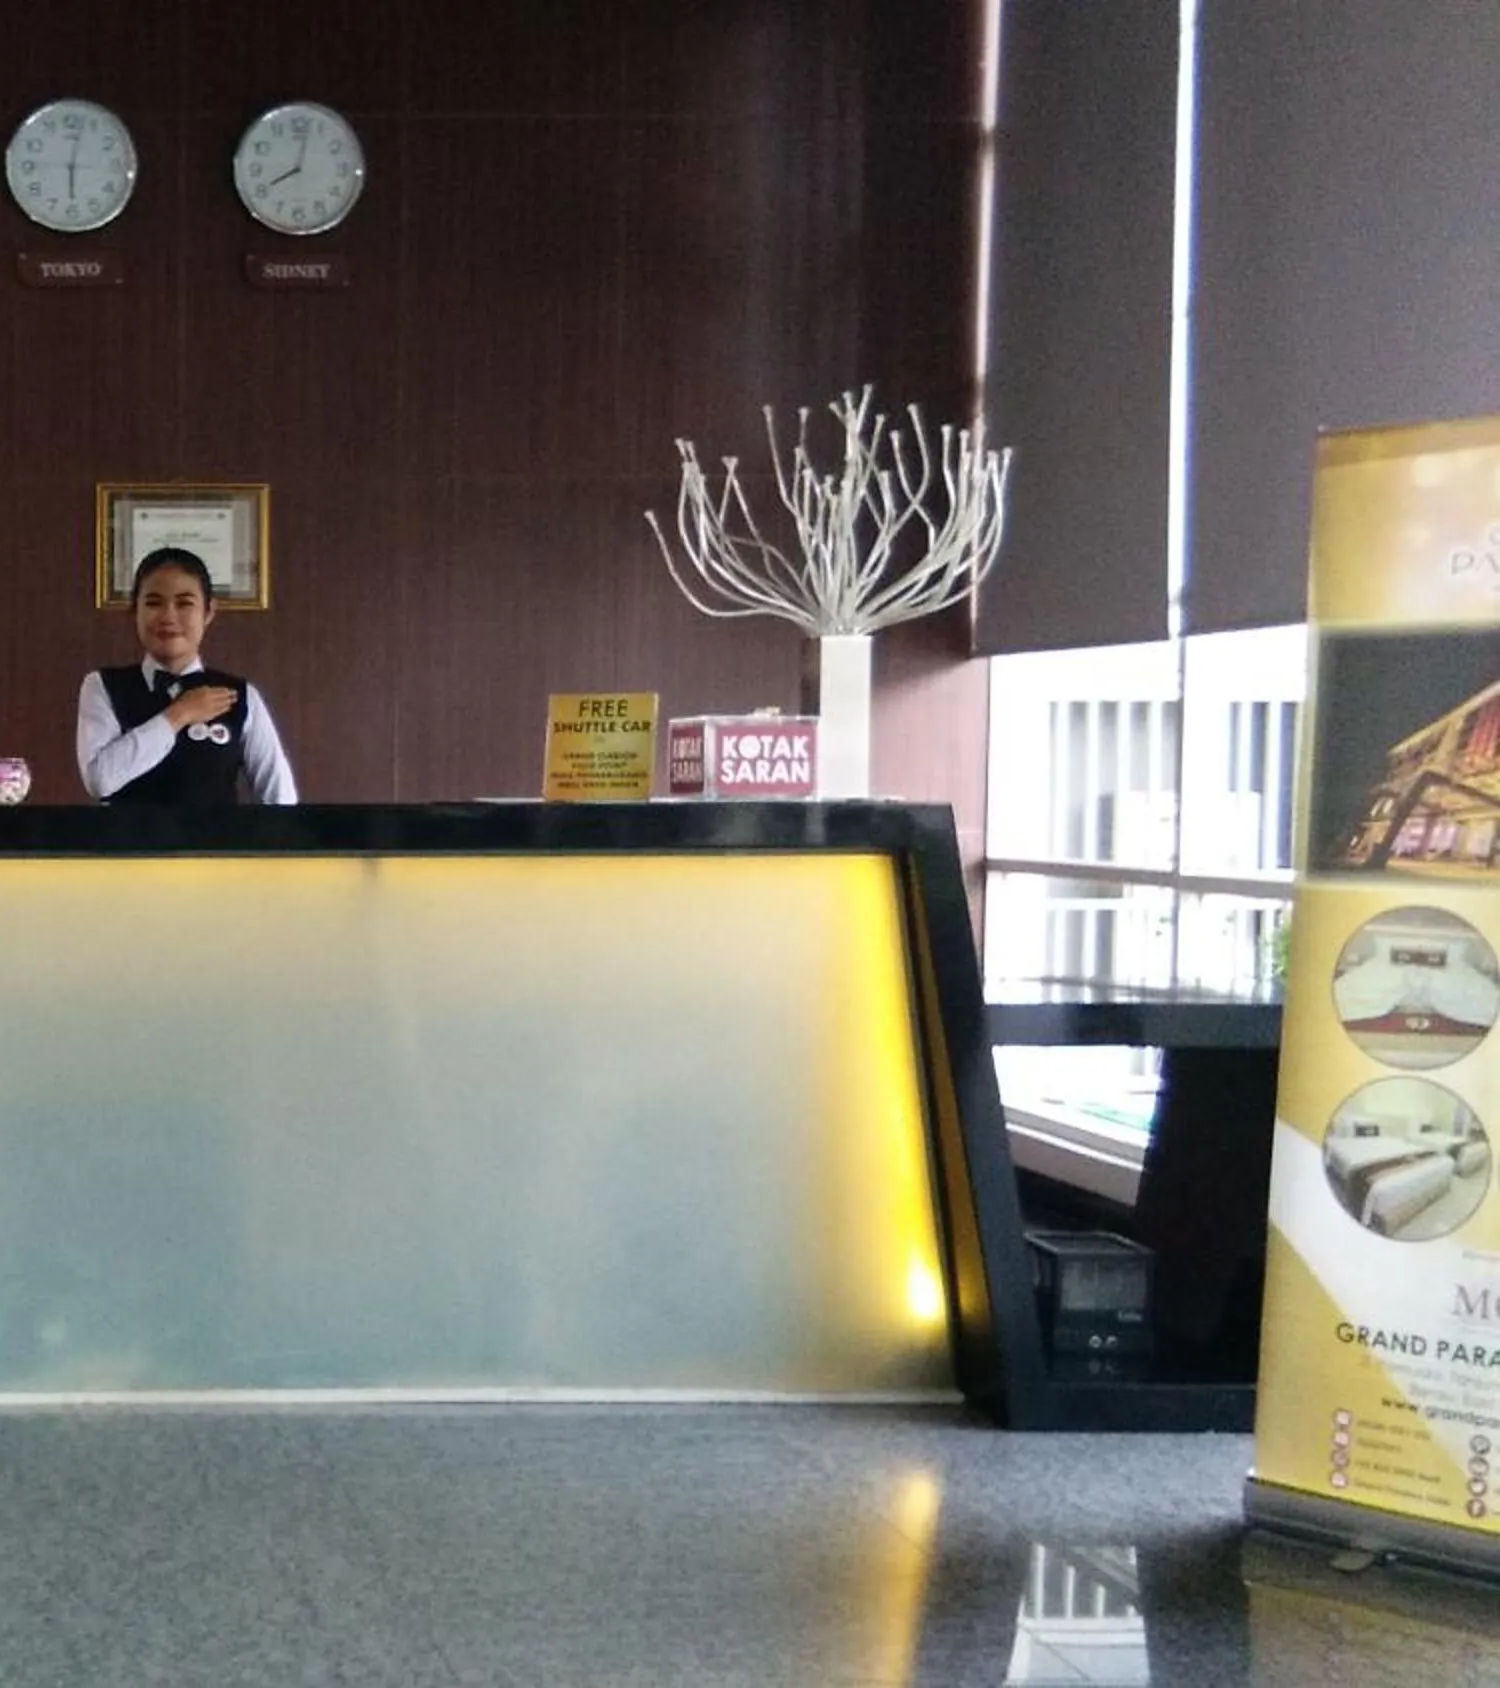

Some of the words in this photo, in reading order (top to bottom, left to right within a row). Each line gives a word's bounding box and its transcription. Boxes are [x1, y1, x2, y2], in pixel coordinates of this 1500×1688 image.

[40, 261, 102, 277] TOKYO
[262, 262, 331, 279] SIDNEY
[579, 699, 628, 717] FREE
[553, 720, 616, 734] SHUTTLE
[621, 720, 651, 733] CAR
[722, 735, 809, 759] KOTAK
[721, 760, 810, 784] SARAN
[1335, 1321, 1427, 1356] GRAND
